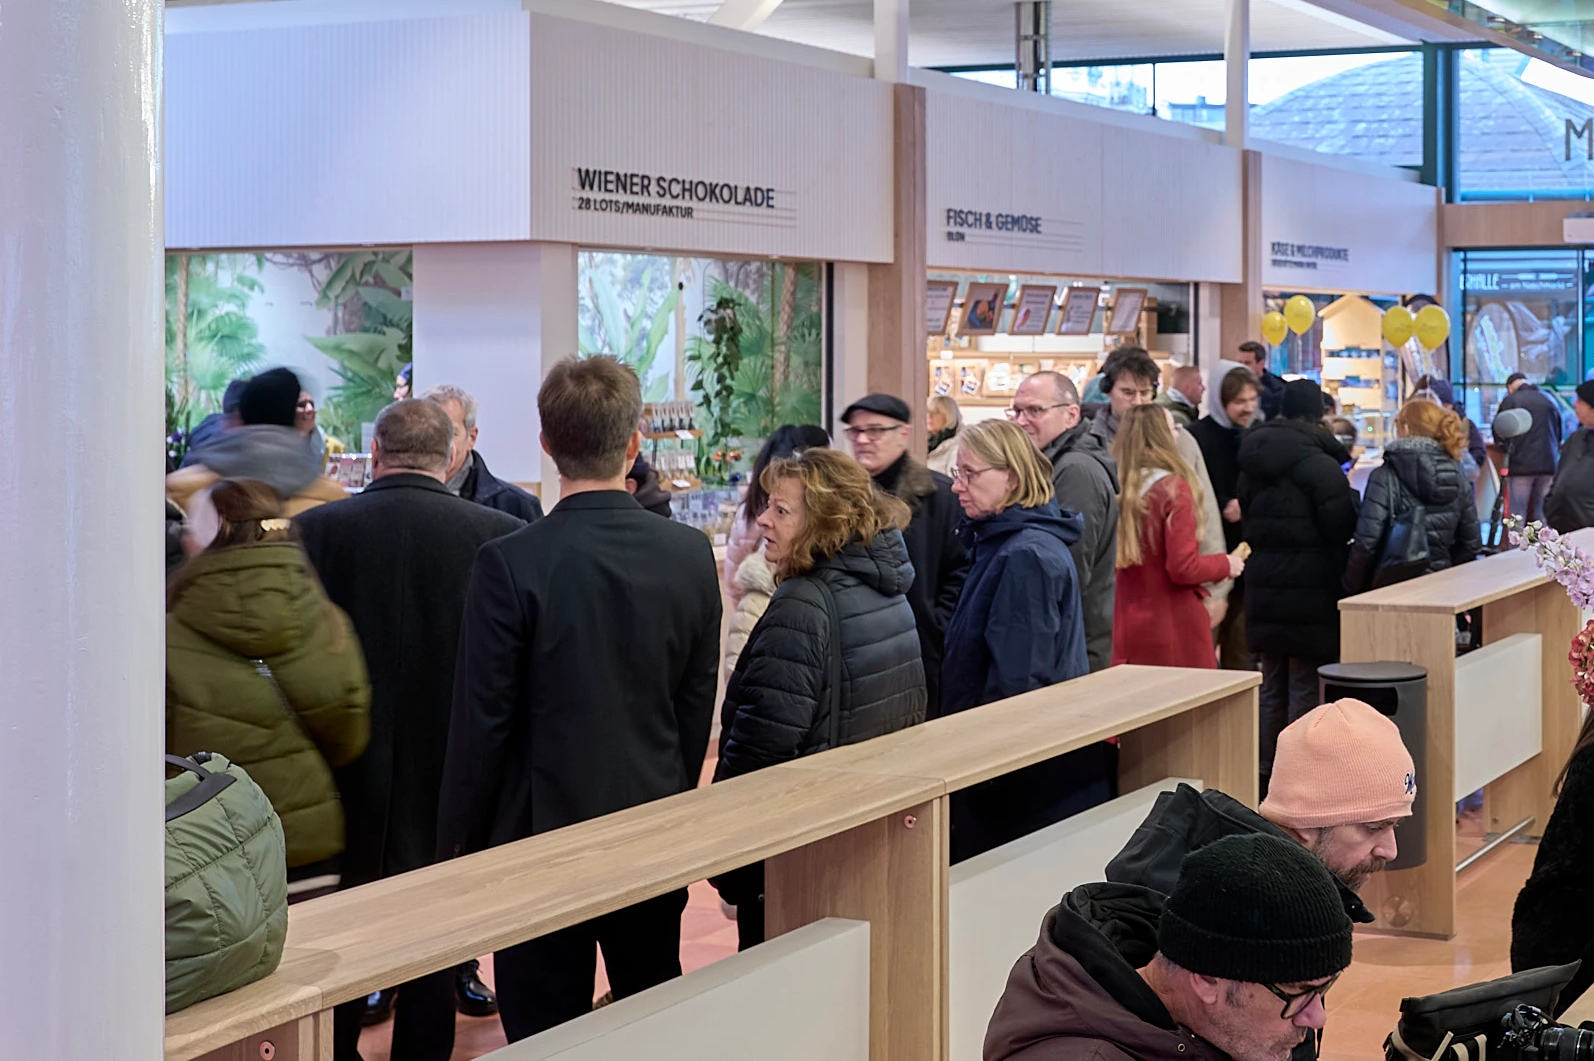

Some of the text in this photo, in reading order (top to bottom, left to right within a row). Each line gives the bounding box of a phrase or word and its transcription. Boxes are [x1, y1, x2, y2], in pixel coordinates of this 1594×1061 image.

[577, 167, 775, 208] WIENER SCHOKOLADE
[577, 196, 693, 219] 28 LOTS/MANUFAKTUR
[946, 208, 982, 229] FISCH
[984, 212, 992, 229] &
